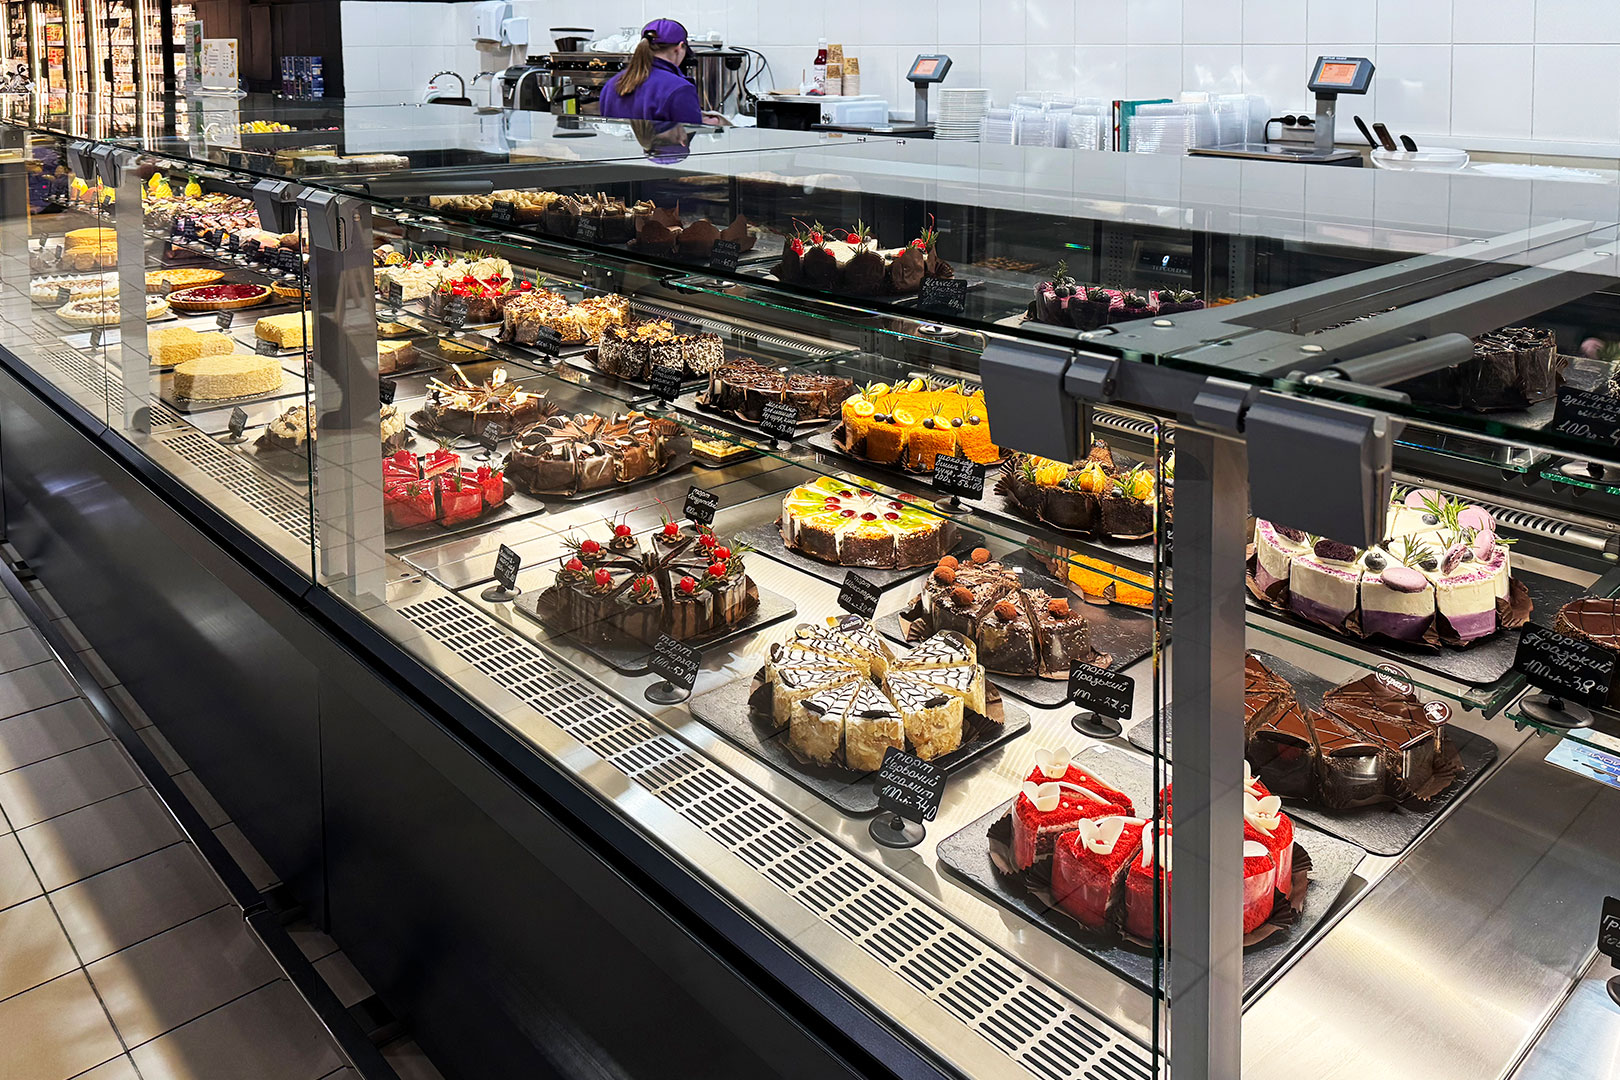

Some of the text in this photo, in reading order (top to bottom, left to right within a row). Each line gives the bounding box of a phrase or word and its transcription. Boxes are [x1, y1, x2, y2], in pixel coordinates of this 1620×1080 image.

[658, 634, 693, 657] торт
[1537, 628, 1590, 652] торт
[654, 641, 700, 672] Естерхазі
[1521, 632, 1614, 675] Празький
[1072, 669, 1129, 692] Празький
[1079, 663, 1116, 679] торт
[884, 756, 941, 788] Червоний
[893, 752, 935, 774] торт
[880, 770, 935, 800] оксамит
